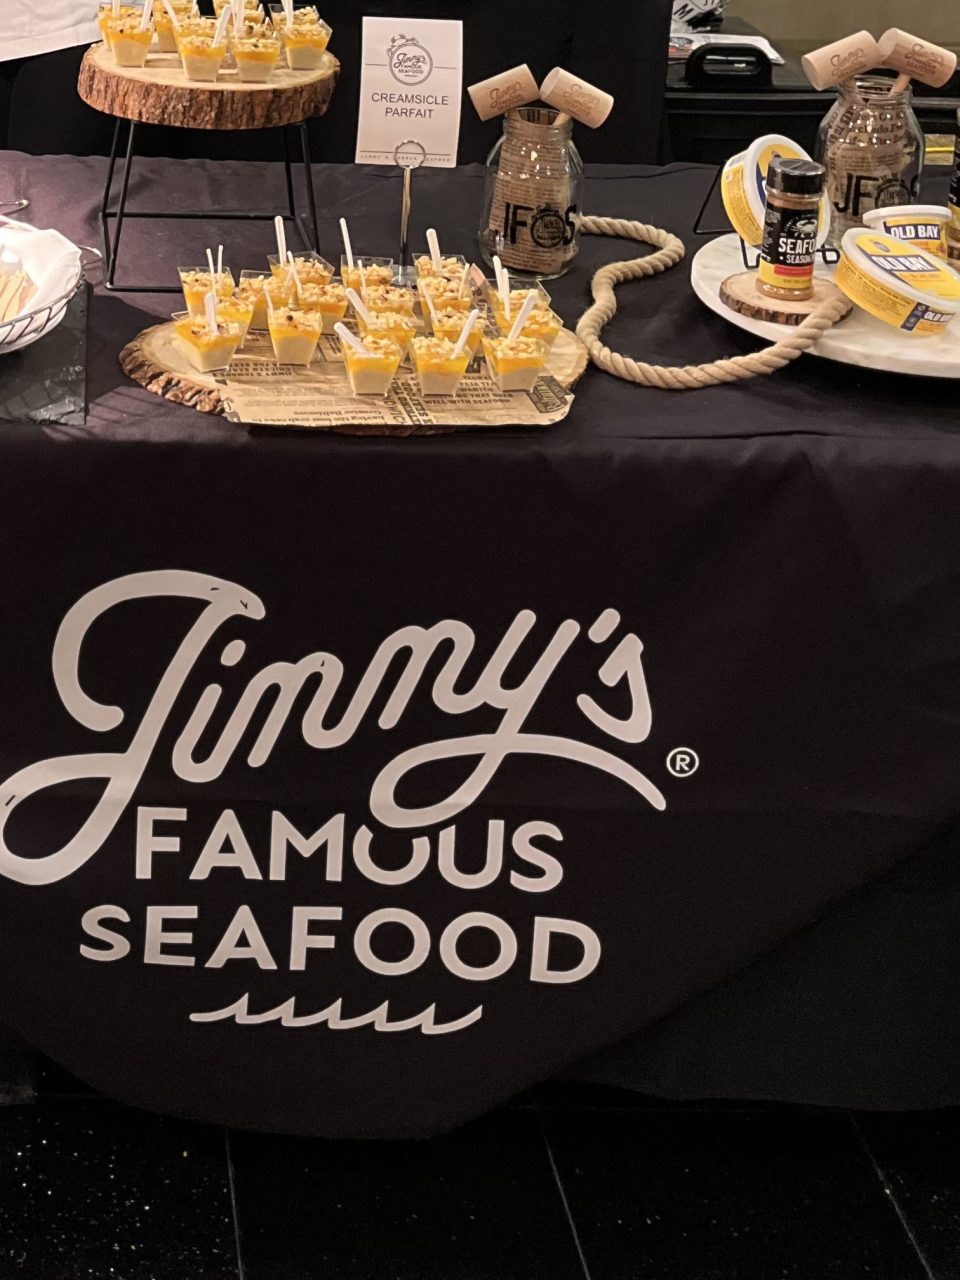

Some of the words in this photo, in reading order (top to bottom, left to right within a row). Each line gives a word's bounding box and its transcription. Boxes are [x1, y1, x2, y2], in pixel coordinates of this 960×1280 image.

[371, 92, 449, 106] CREAMSICLE
[385, 107, 434, 119] PARFAIT
[890, 225, 917, 239] OLD
[917, 225, 939, 238] BAY
[135, 806, 564, 893] FAMOUS
[79, 904, 601, 984] SEAFOOD
